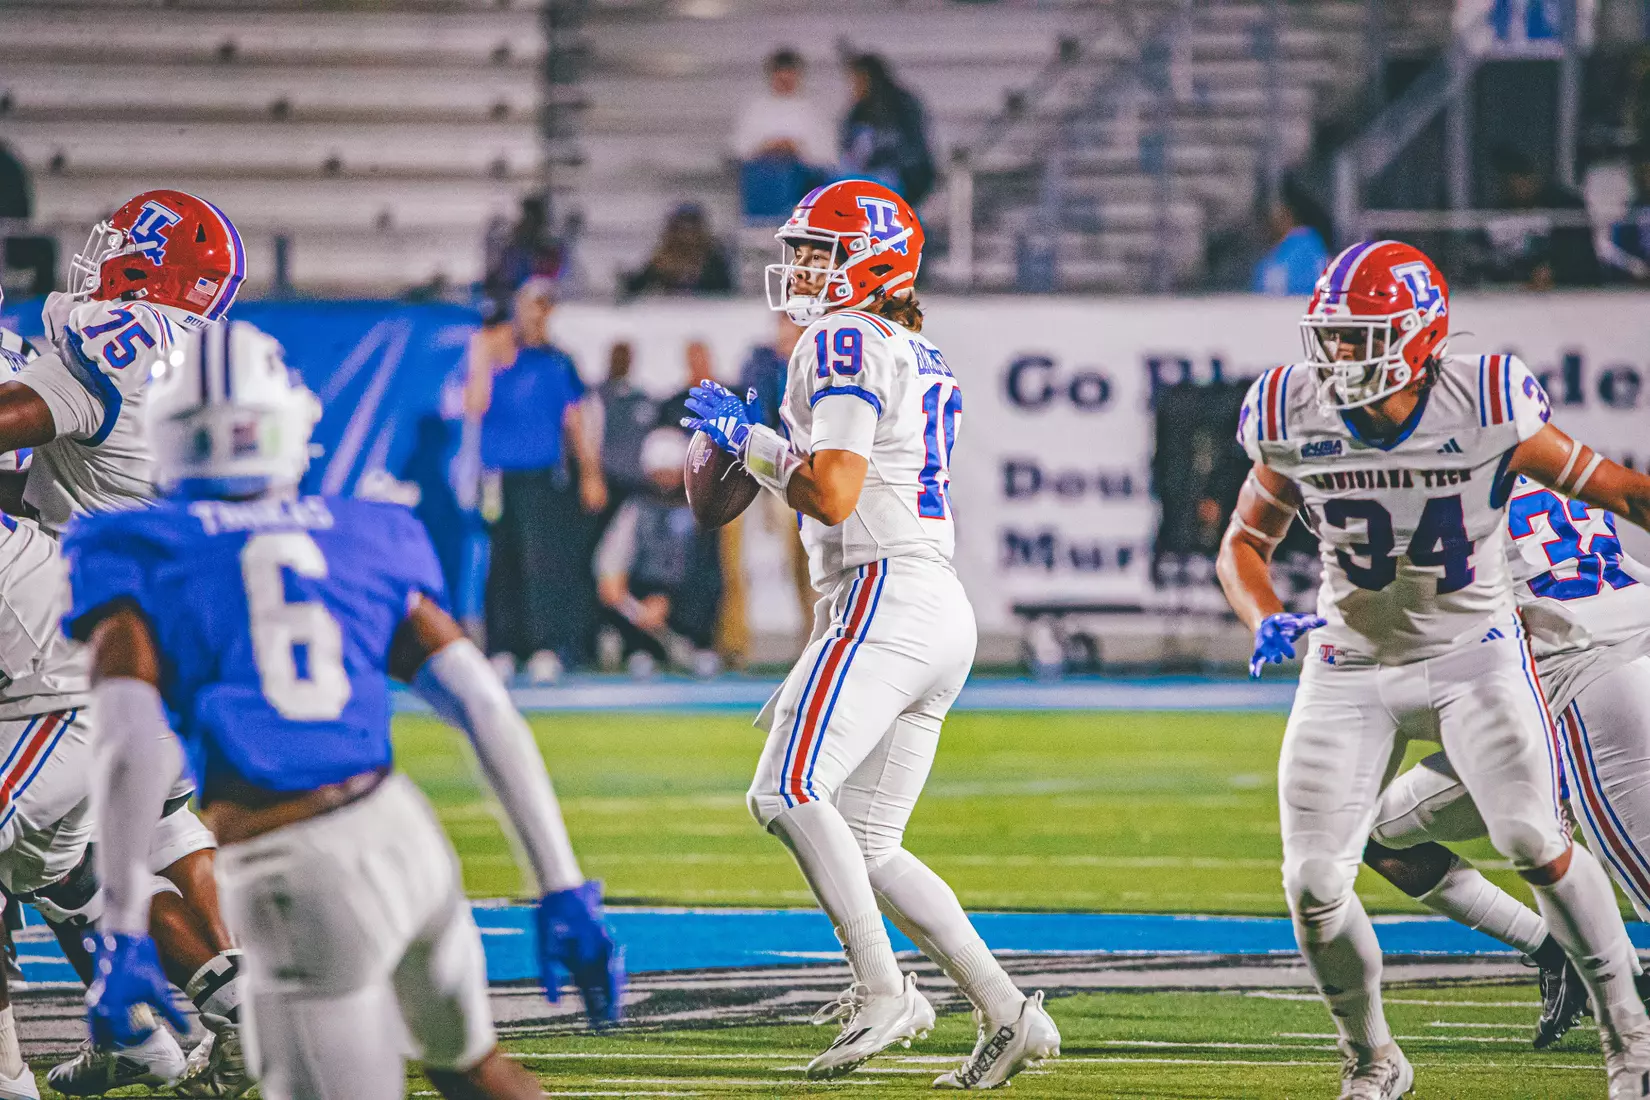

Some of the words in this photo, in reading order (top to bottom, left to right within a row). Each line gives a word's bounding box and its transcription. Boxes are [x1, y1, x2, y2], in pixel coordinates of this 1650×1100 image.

[82, 309, 156, 370] 75
[814, 328, 863, 378] 19
[1006, 355, 1110, 412] Go
[1003, 459, 1134, 499] Dou
[1312, 470, 1414, 490] LOUISIANA
[1420, 469, 1472, 488] TECH
[1323, 494, 1476, 592] 34
[239, 531, 352, 721] 6
